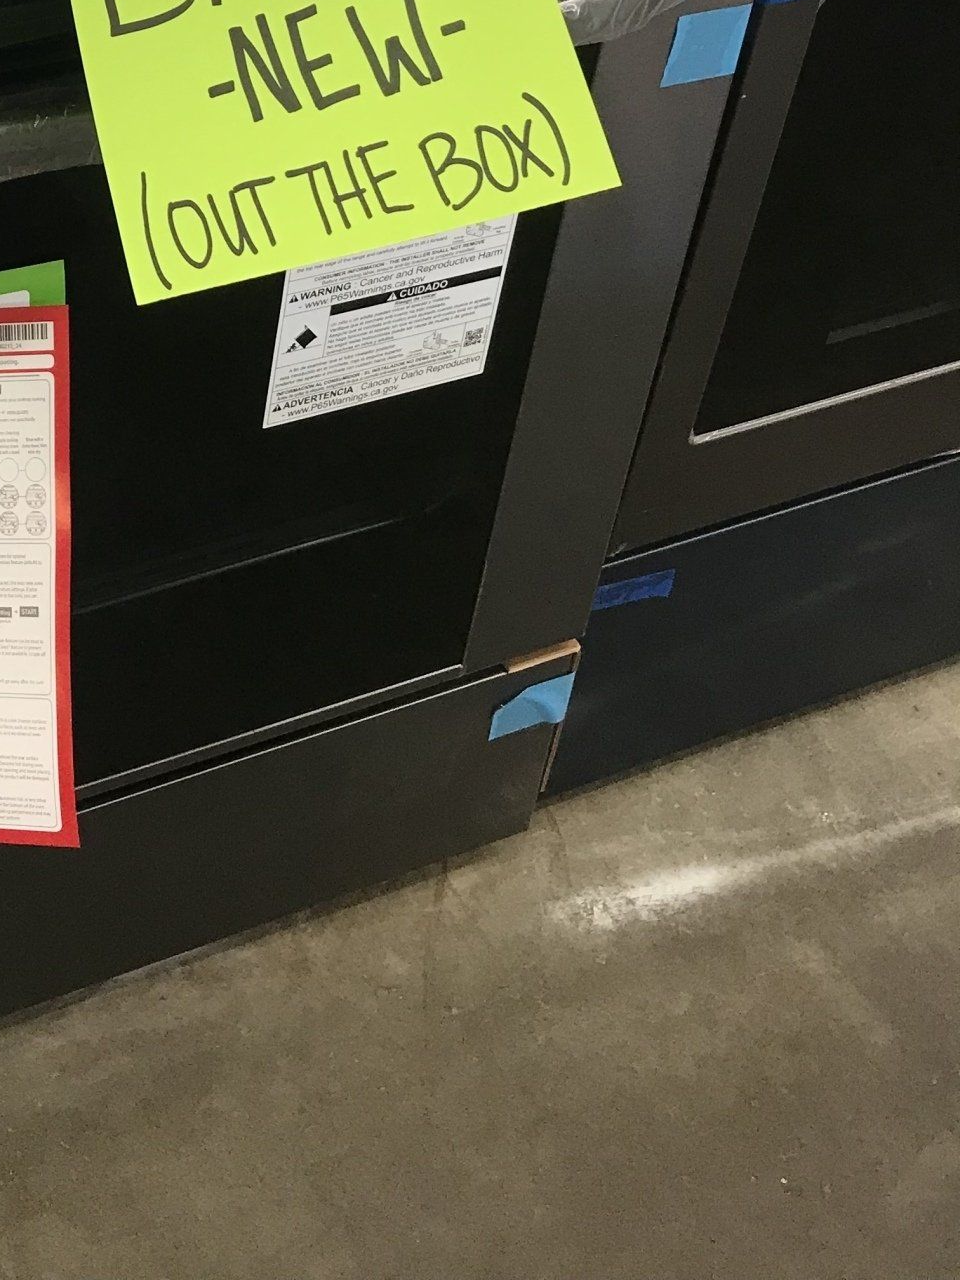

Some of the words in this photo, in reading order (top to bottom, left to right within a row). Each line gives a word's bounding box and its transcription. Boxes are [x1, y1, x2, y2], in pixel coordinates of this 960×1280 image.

[140, 171, 276, 291] (OUT
[286, 140, 416, 237] THE
[418, 91, 572, 212] BOX)
[300, 282, 352, 301] WARNING
[360, 273, 393, 287] Cancer
[395, 267, 414, 279] and
[416, 254, 476, 274] Reproductive
[477, 248, 503, 260] Harm
[399, 279, 448, 298] CUIDADO
[283, 385, 354, 410] ADVERTENCIA
[393, 376, 400, 385] y
[425, 355, 481, 374] Reproductivo
